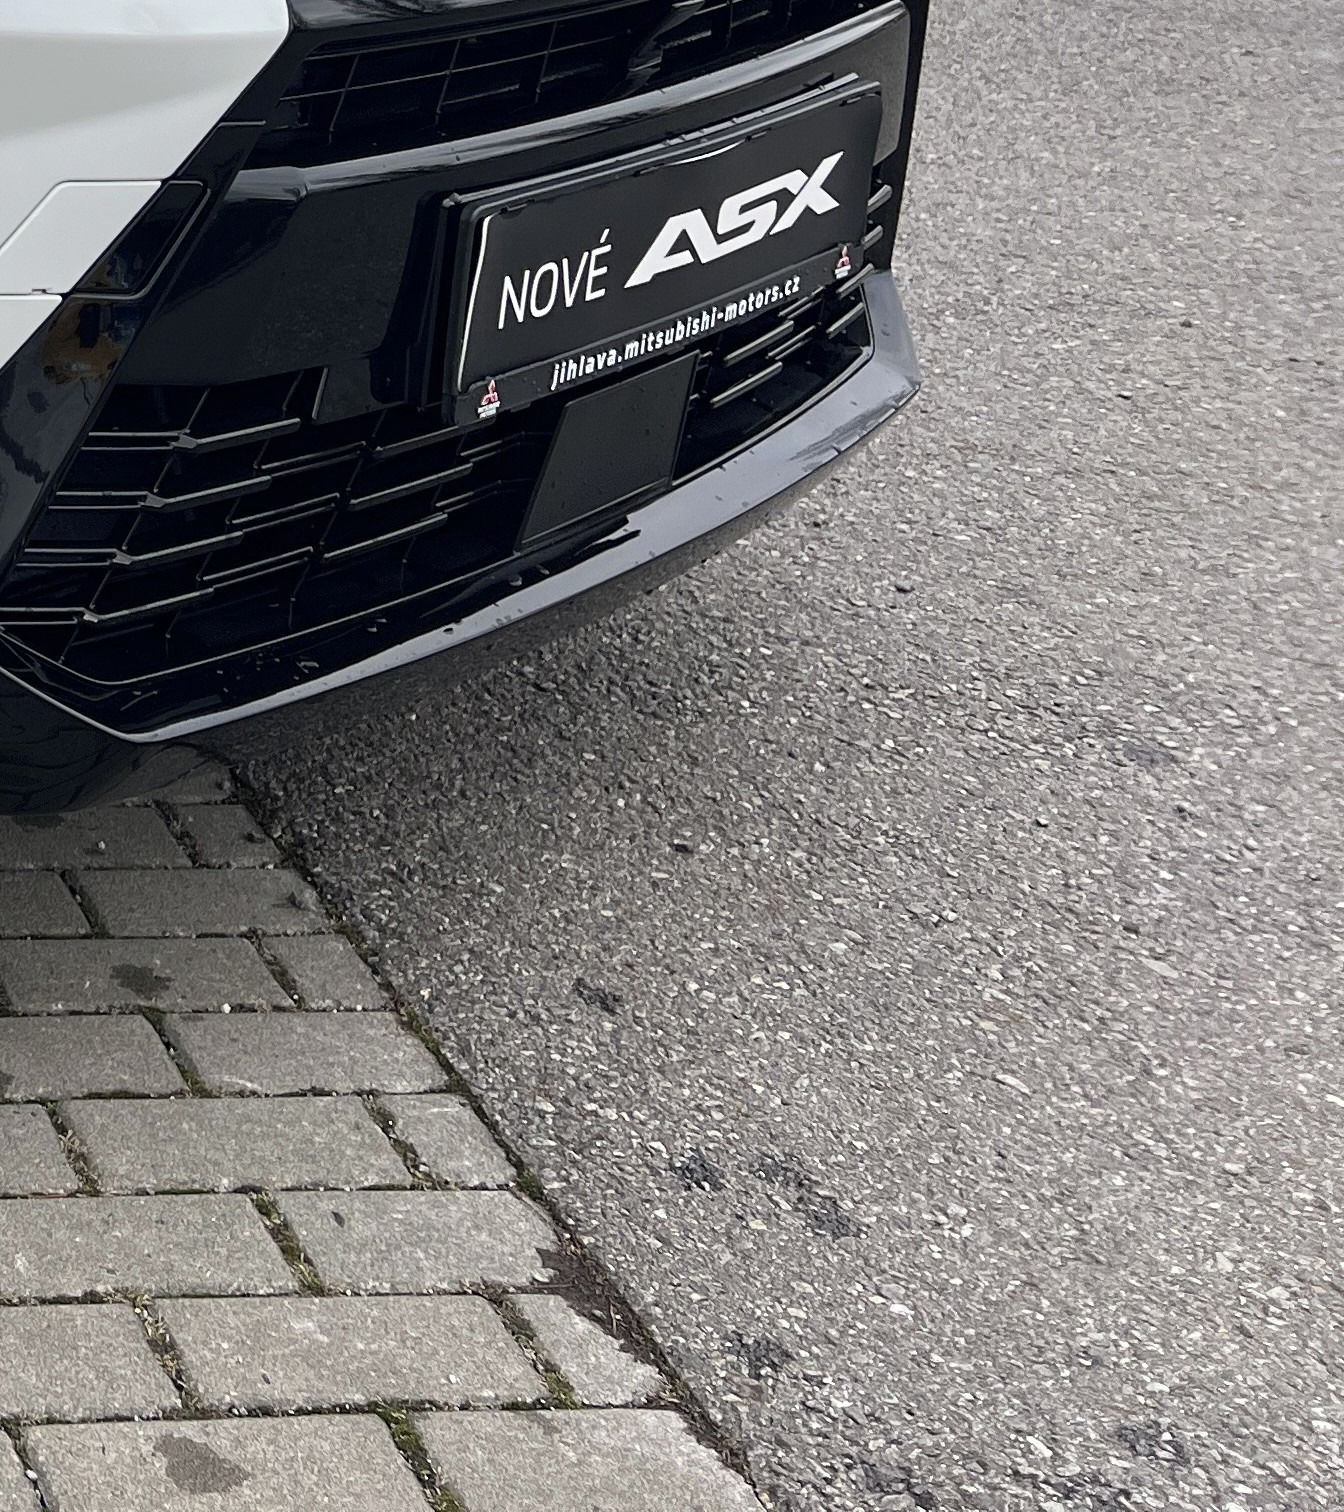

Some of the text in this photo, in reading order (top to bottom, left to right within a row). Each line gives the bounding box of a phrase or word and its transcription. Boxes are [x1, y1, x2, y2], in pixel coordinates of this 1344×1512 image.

[497, 150, 845, 330] NOVÉ ASX
[549, 274, 802, 391] jihlava.mitsubishi-motors.cz
